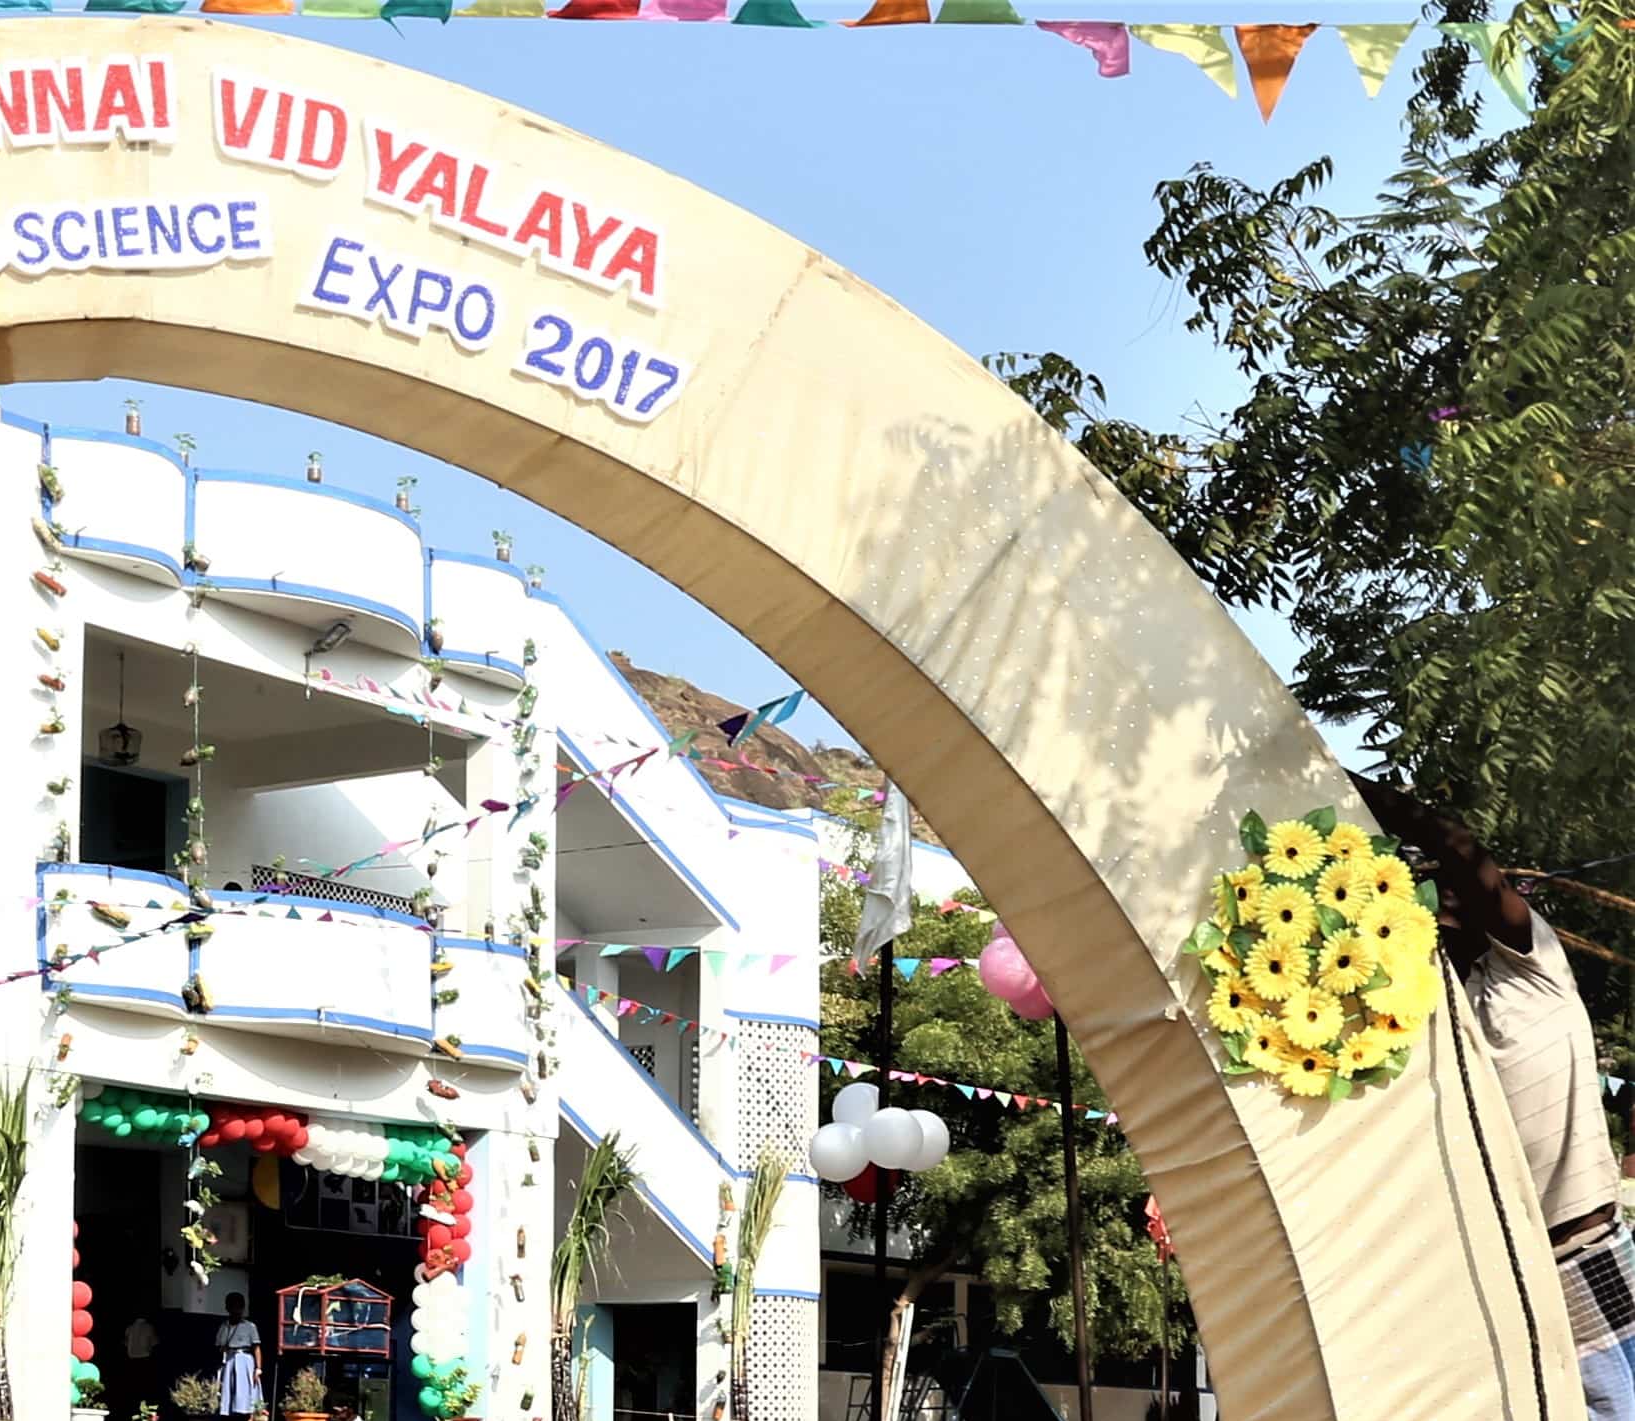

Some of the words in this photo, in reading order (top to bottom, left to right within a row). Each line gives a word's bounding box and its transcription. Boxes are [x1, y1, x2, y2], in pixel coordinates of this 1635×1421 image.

[222, 79, 347, 169] VID
[375, 129, 657, 294] YALAYA
[16, 201, 261, 265] SCIENCE
[313, 239, 495, 342] EXPO
[527, 314, 681, 413] 2017
